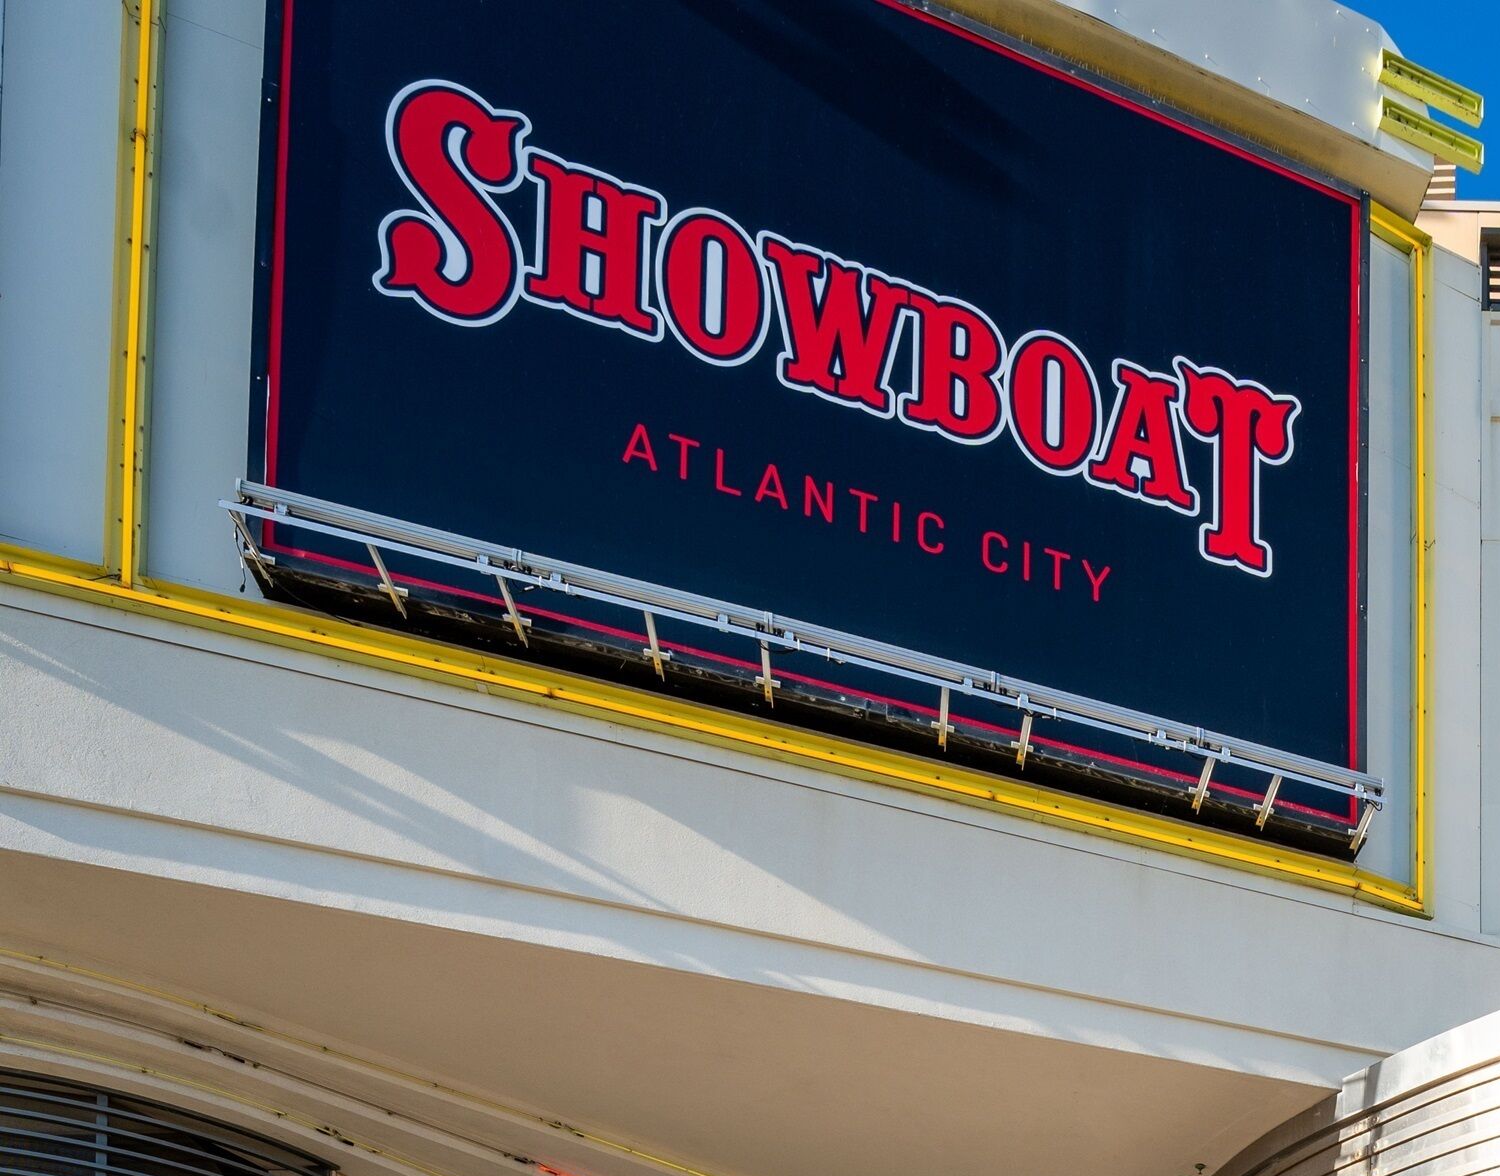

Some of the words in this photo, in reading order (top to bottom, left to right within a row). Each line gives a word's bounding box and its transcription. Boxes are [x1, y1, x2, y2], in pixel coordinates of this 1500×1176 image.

[371, 78, 1302, 580] SHOWBOAT
[621, 423, 946, 556] ATLANTIC
[979, 530, 1112, 602] CITY
